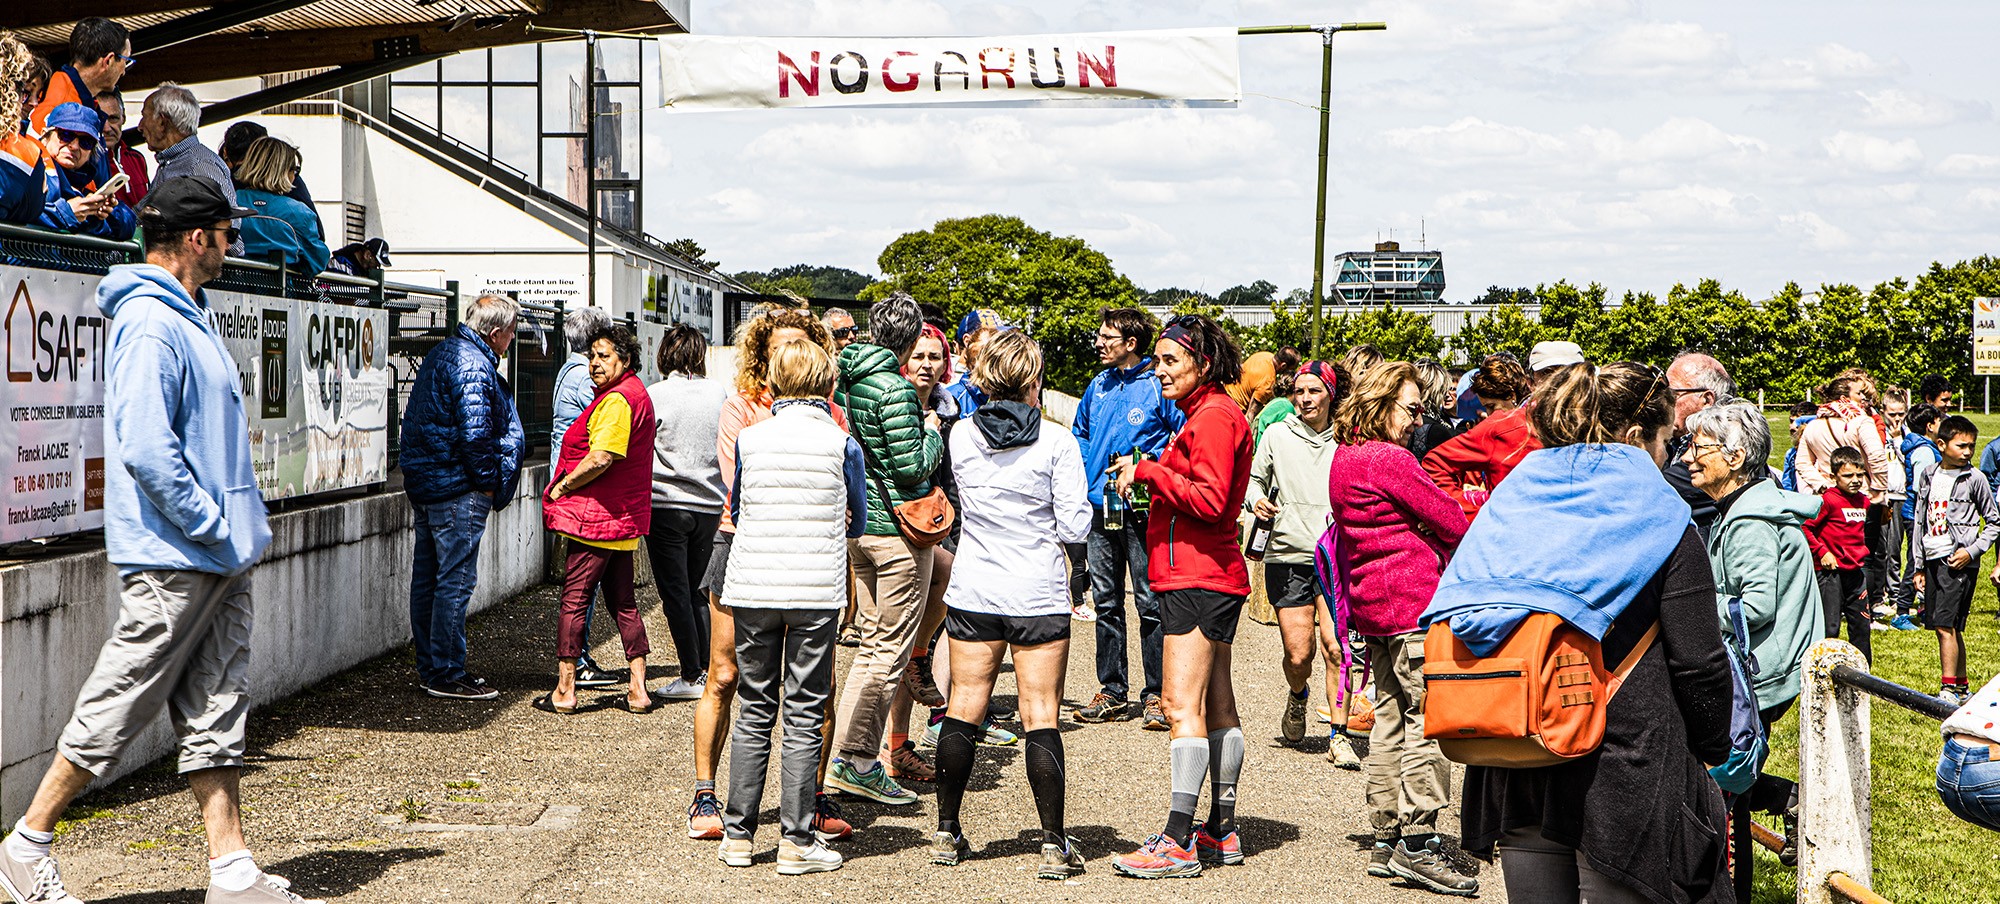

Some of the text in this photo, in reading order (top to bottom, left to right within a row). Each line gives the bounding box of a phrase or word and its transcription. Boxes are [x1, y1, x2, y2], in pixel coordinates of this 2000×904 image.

[778, 45, 1118, 98] NOGARUN
[263, 319, 287, 339] ADOUR
[37, 310, 106, 382] SAFTI
[307, 313, 361, 370] CAFPI
[1976, 351, 1985, 360] LA
[10, 406, 30, 422] VOTRE
[30, 406, 65, 421] CONSEILLER
[66, 404, 95, 419] IMMOBILIER
[17, 442, 69, 463] Franck LACAZE
[27, 474, 36, 491] 06
[37, 473, 45, 490] 48
[46, 472, 55, 490] 70
[55, 471, 64, 489] 67
[64, 470, 72, 488] 31
[8, 499, 77, 525] franck.lacaze@safti.fr
